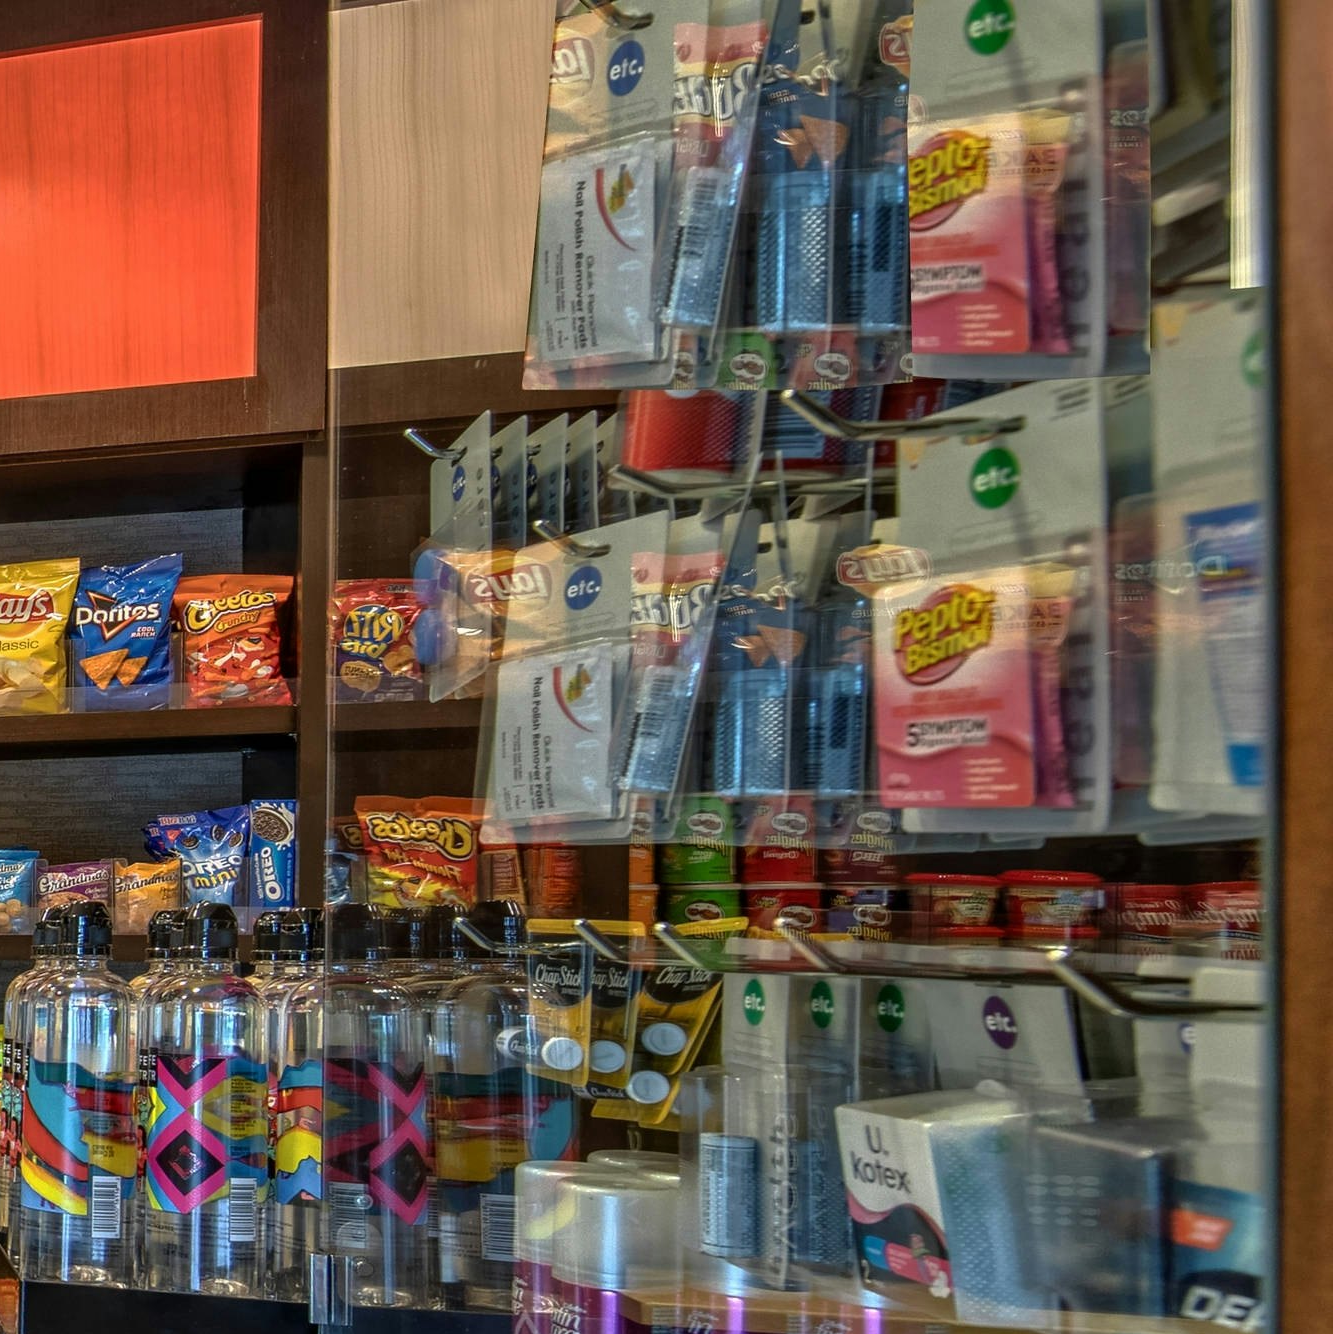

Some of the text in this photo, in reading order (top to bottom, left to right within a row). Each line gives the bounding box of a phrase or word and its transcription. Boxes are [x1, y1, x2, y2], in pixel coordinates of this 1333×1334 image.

[968, 9, 1015, 38] etc.
[609, 48, 645, 81] etc.
[910, 138, 990, 183] epto-
[574, 180, 587, 349] Nail Polish Remover Pads
[973, 465, 1021, 492] etc.
[566, 575, 601, 598] etc.
[75, 602, 161, 626] Doritos
[186, 590, 277, 634] Cheetos
[213, 609, 261, 632] Crunchy
[904, 625, 993, 676] Bismol
[532, 676, 546, 810] Nail Polish Remover Pads
[906, 722, 920, 748] 5
[183, 854, 242, 874] OREO
[259, 847, 283, 901] OREO
[37, 871, 109, 895] Grandma's
[193, 868, 239, 888] mini
[744, 994, 765, 1009] etc.
[811, 996, 834, 1013] etc.
[877, 998, 905, 1019] etc.
[984, 1013, 1017, 1036] etc.
